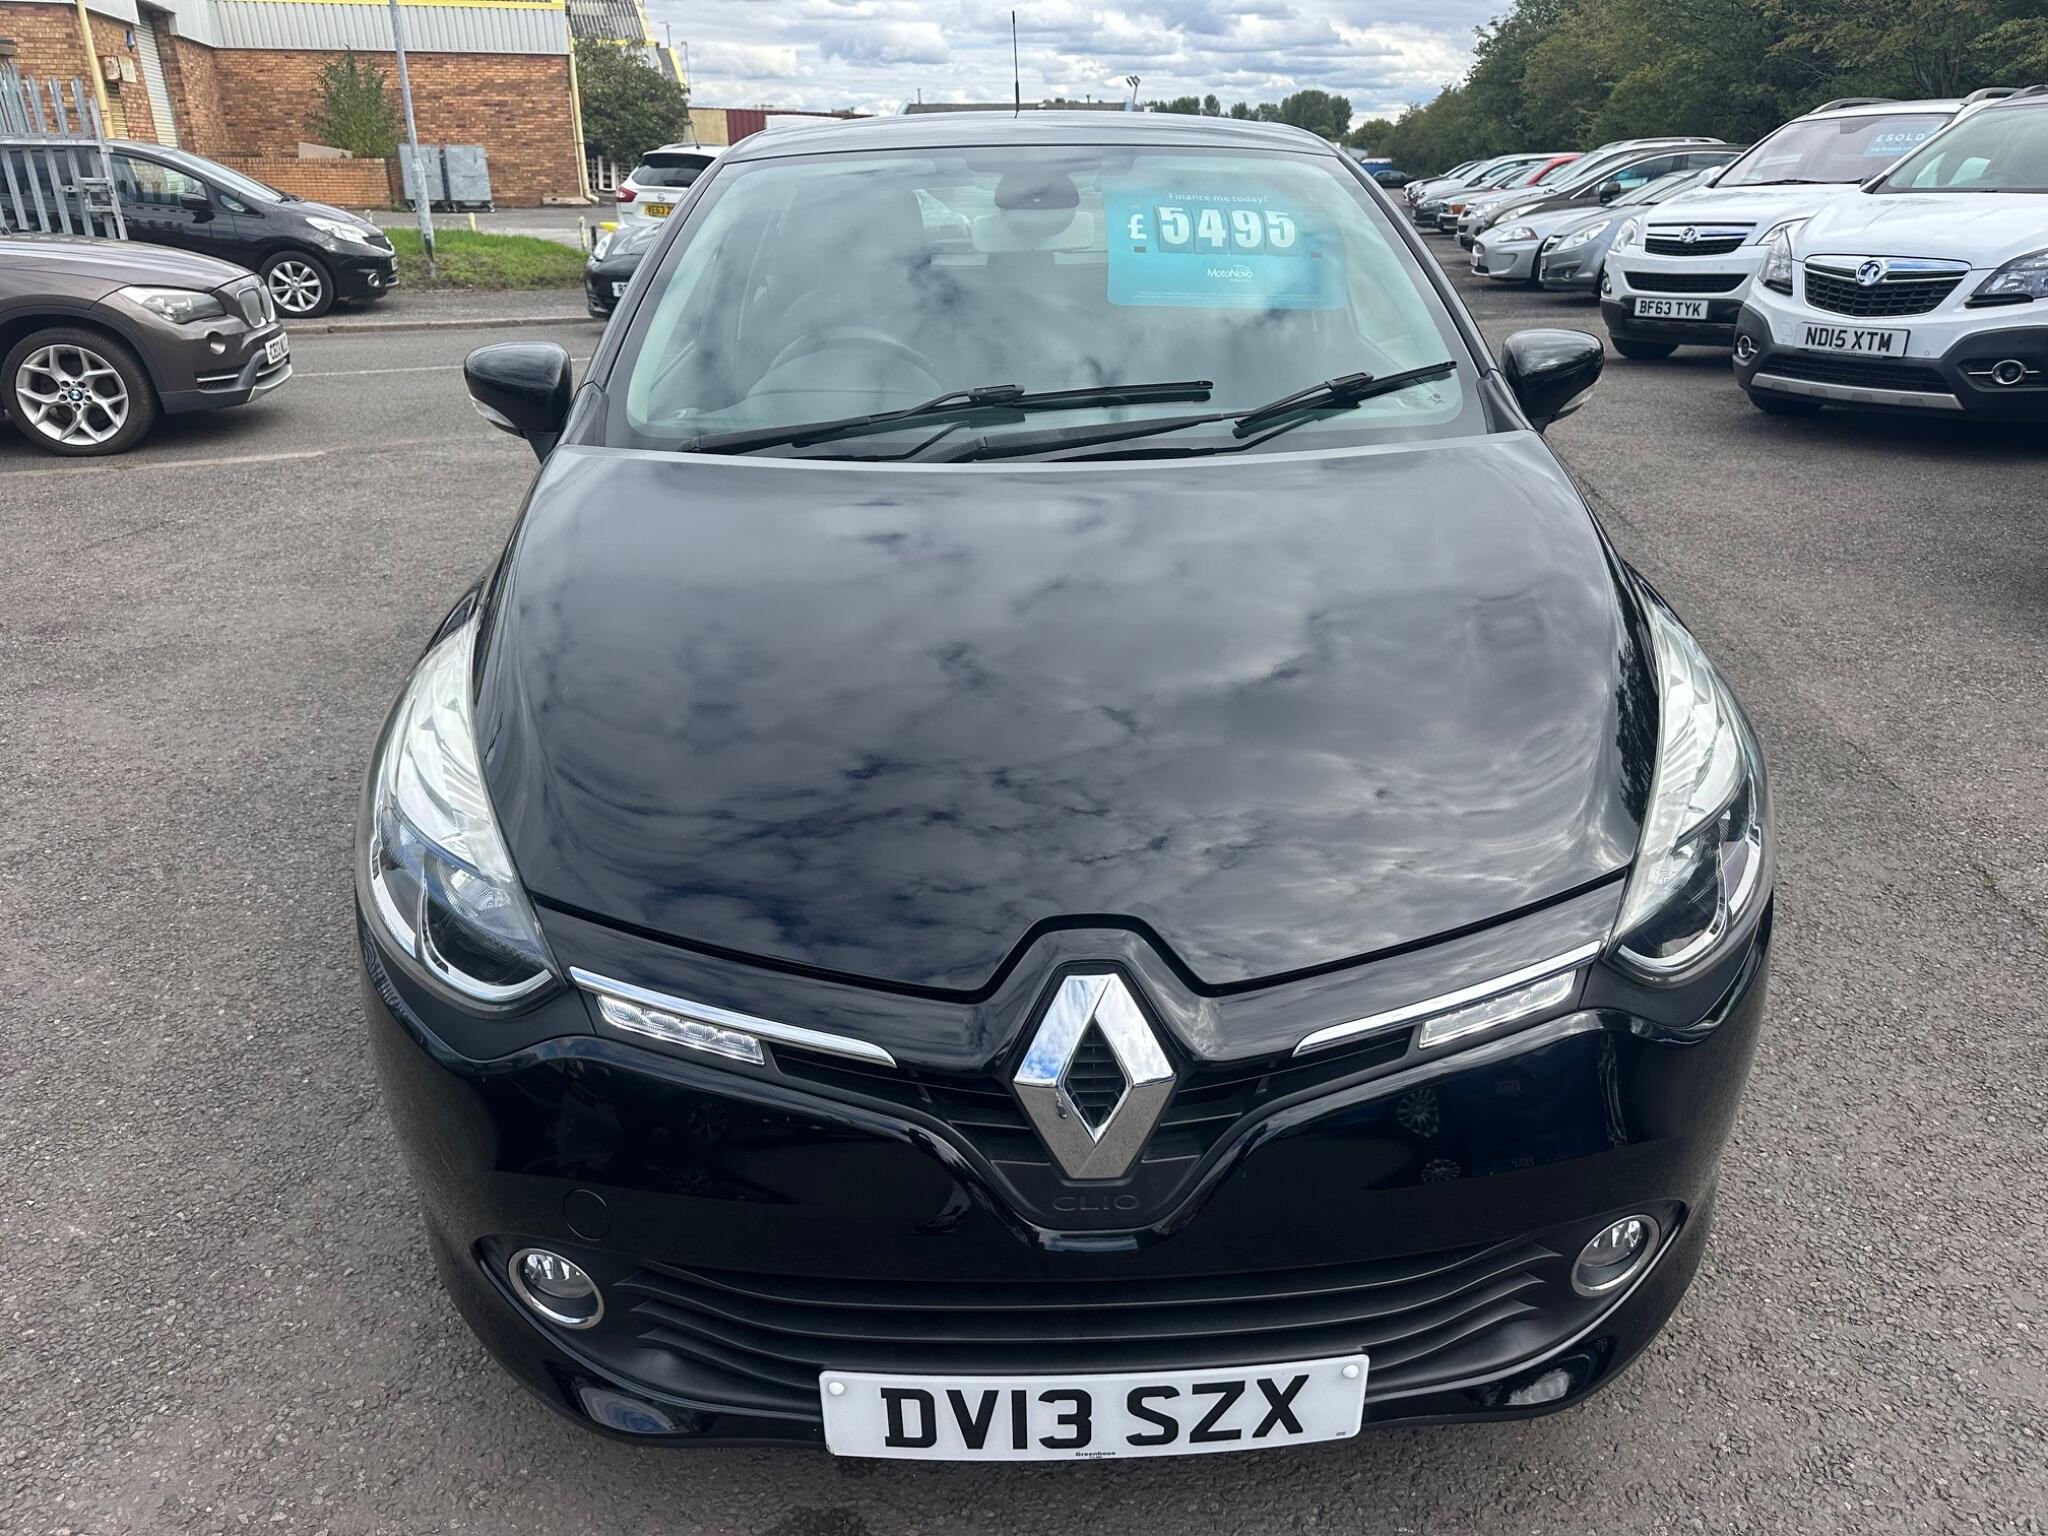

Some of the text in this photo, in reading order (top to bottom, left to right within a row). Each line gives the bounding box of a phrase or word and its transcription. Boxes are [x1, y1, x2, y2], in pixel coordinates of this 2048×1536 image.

[1639, 300, 1702, 317] BF63 TYK
[1804, 326, 1847, 348] ND15
[1850, 330, 1893, 353] XTM
[1052, 1195, 1140, 1212] CLIO
[879, 1374, 1310, 1450] DV13 SZX
